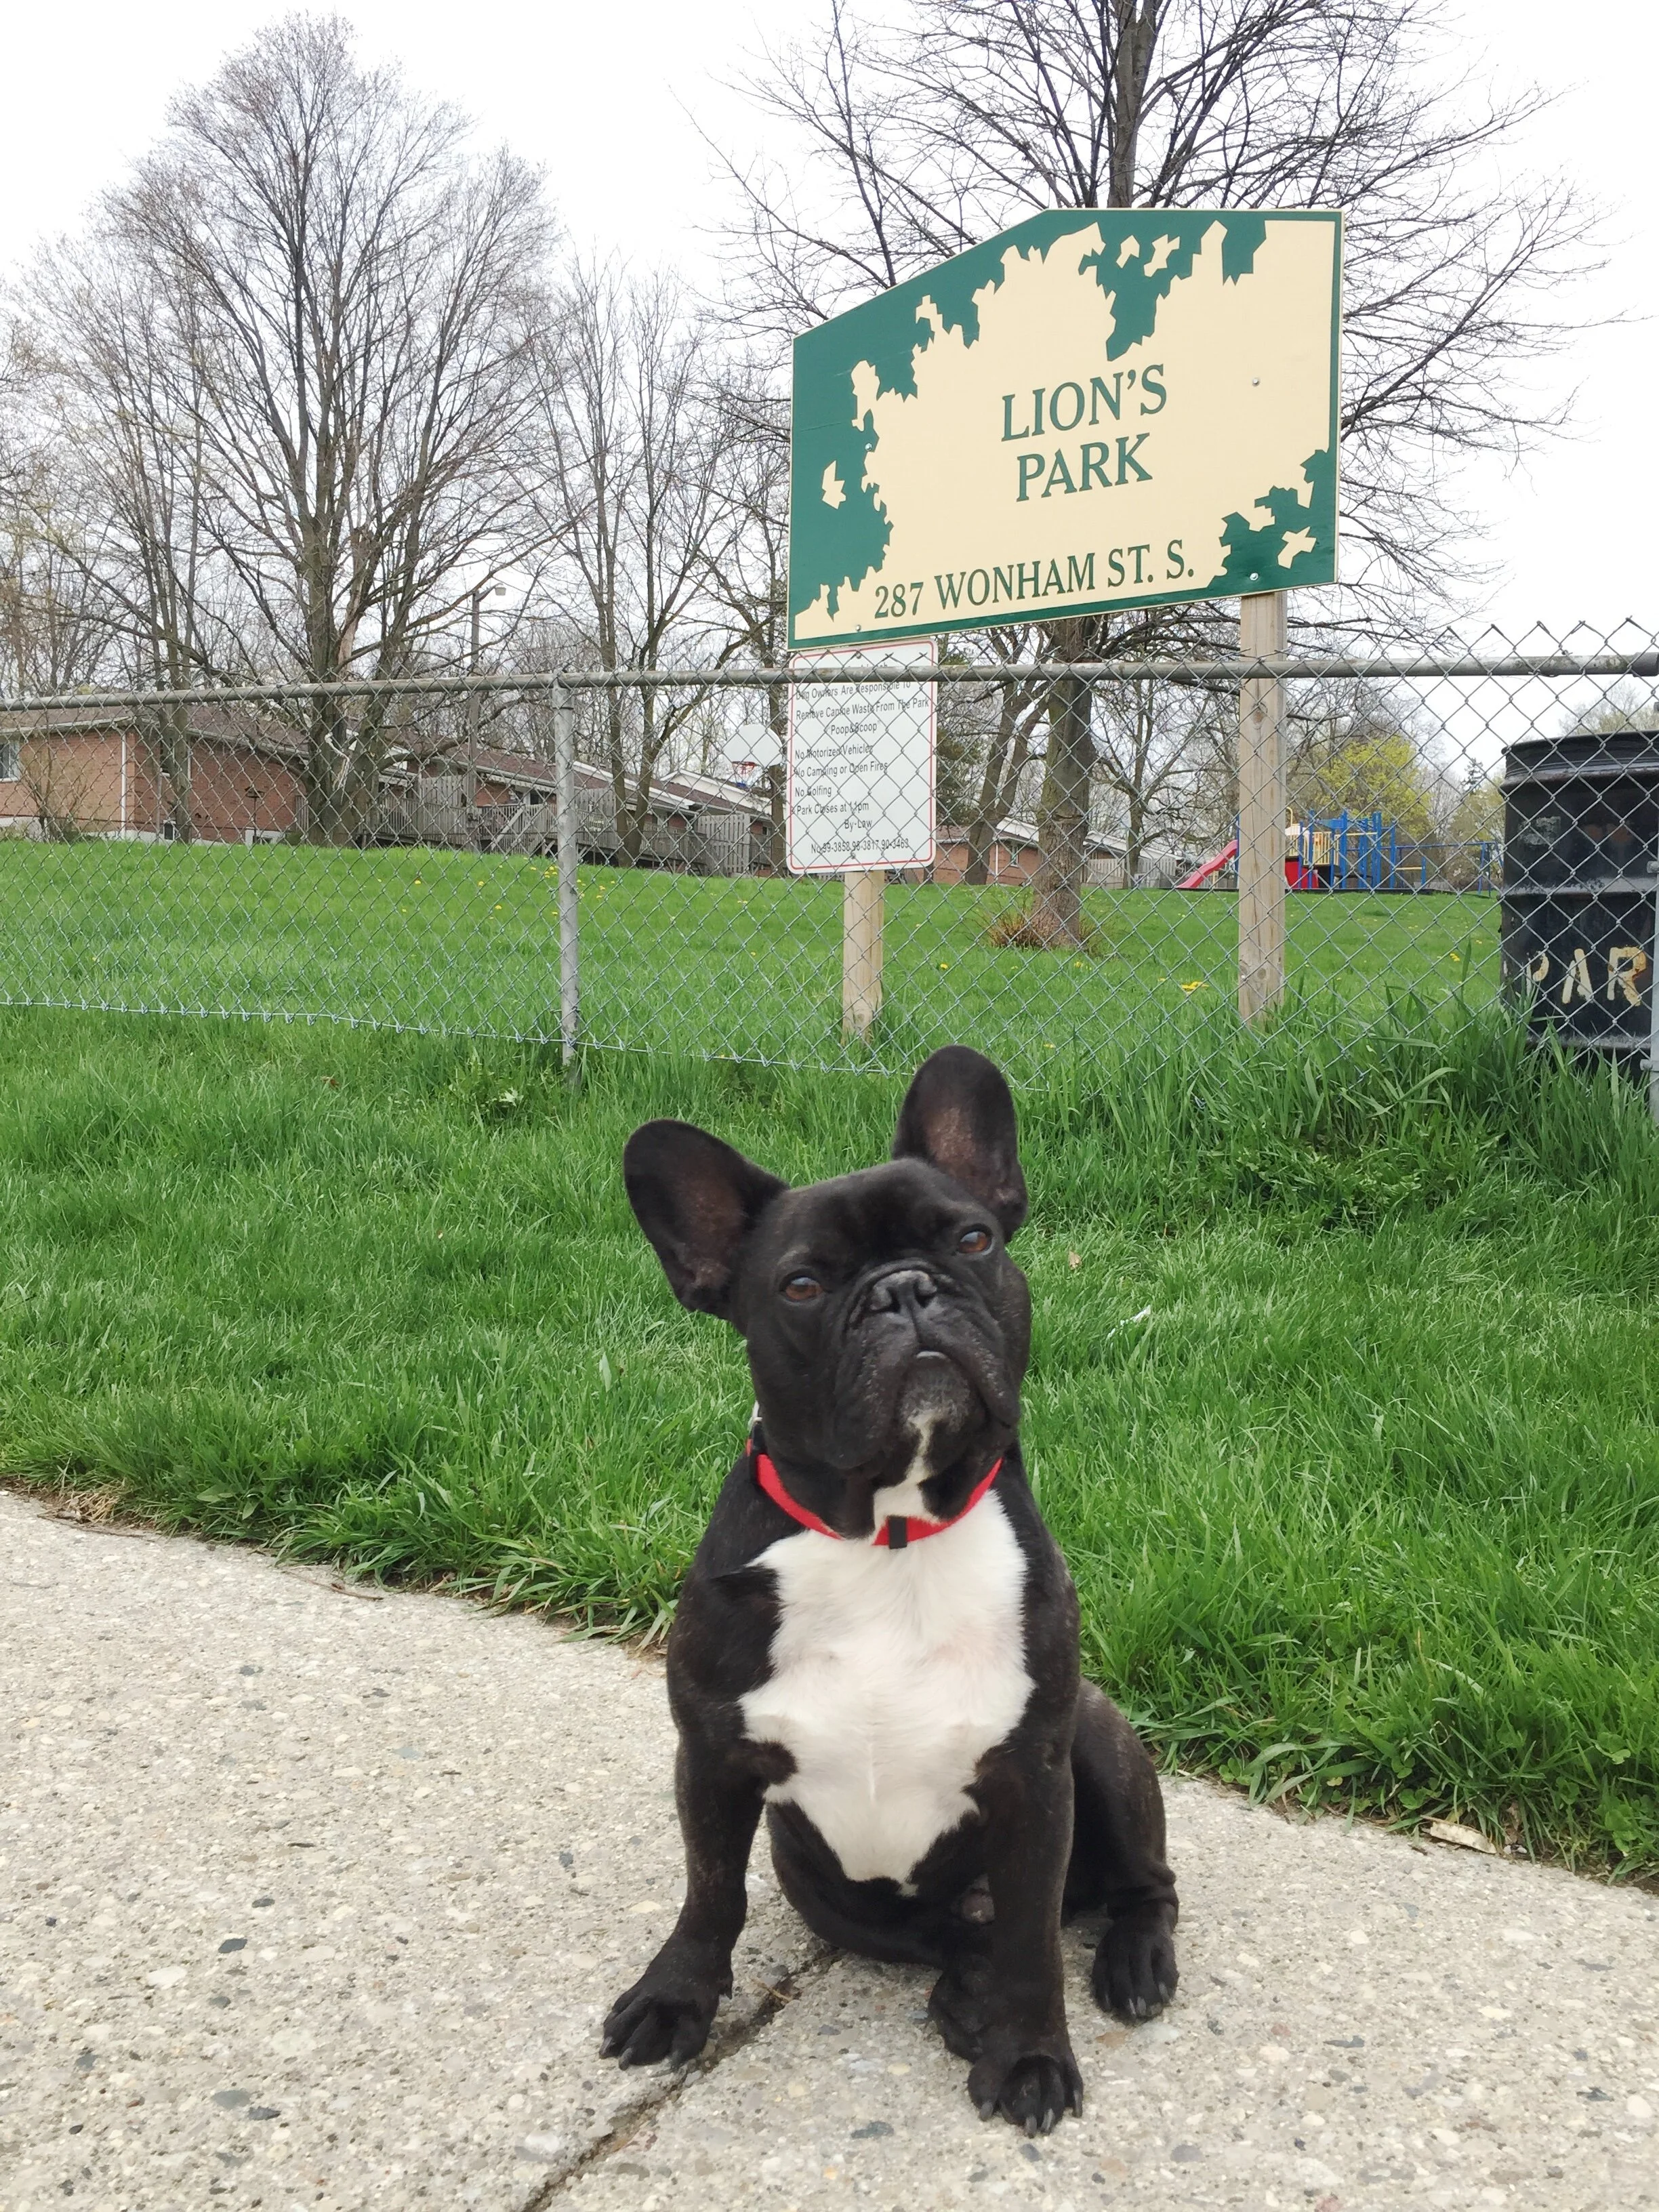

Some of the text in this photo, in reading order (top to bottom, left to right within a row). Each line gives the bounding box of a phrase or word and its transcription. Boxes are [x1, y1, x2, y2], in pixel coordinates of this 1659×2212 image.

[1000, 364, 1168, 443] LION'S
[1015, 432, 1153, 503] PARK
[874, 539, 1194, 619] 287 WONHAM ST. S.
[811, 687, 838, 699] Owners
[840, 684, 853, 695] Are
[796, 697, 929, 720] Remove Canine Waste From The Park
[795, 743, 873, 760] No Motorized Vehicles
[795, 760, 888, 778] No Camping or Open Fires
[795, 785, 832, 797] No Golfing
[797, 800, 869, 815] Park Closes at 11pm
[844, 819, 872, 832] By-Law
